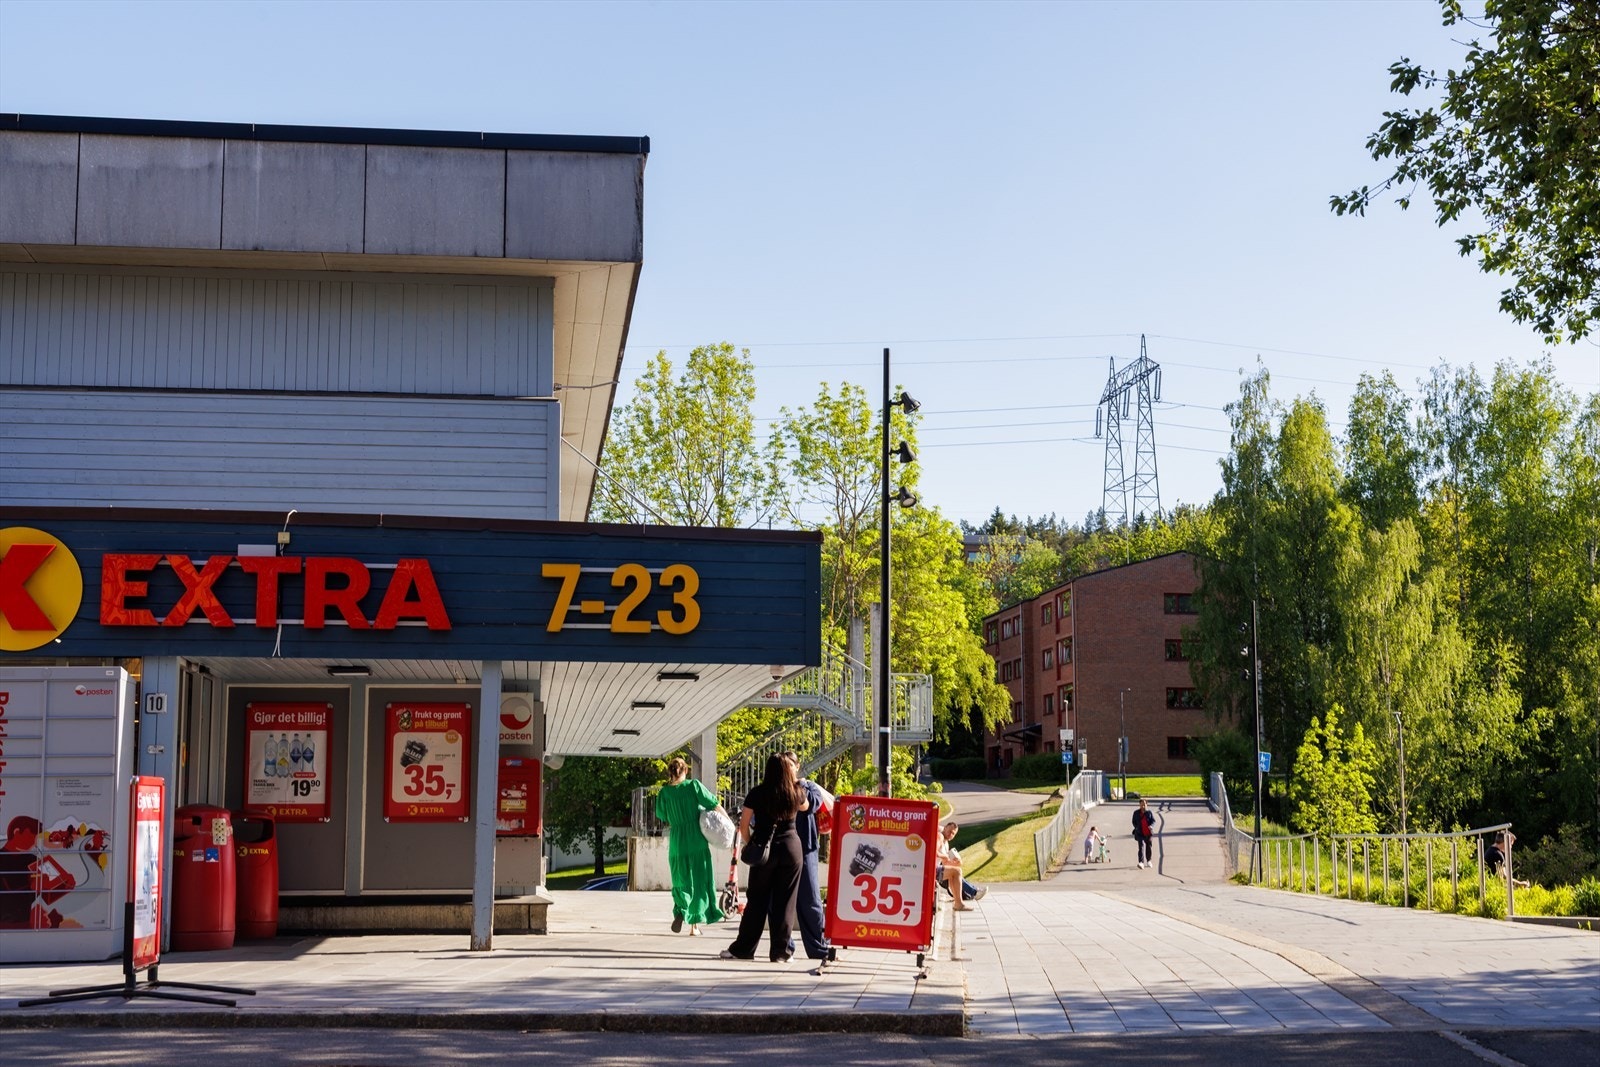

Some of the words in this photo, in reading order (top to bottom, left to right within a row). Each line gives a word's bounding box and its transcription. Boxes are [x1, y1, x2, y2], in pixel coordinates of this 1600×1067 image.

[100, 553, 452, 631] EXTRA
[541, 562, 701, 635] 7-23
[86, 688, 113, 696] posten
[149, 696, 163, 711] 10
[254, 712, 276, 724] Gjør
[278, 712, 296, 723] det
[298, 712, 326, 725] billig!
[443, 711, 462, 720] grønt
[414, 720, 424, 728] på
[425, 720, 448, 728] tilbud!
[870, 808, 890, 818] frukt
[892, 811, 902, 820] og
[904, 811, 927, 820] grønt
[868, 820, 880, 830] på
[881, 820, 910, 830] tilbud!
[870, 928, 900, 938] EXTRA
